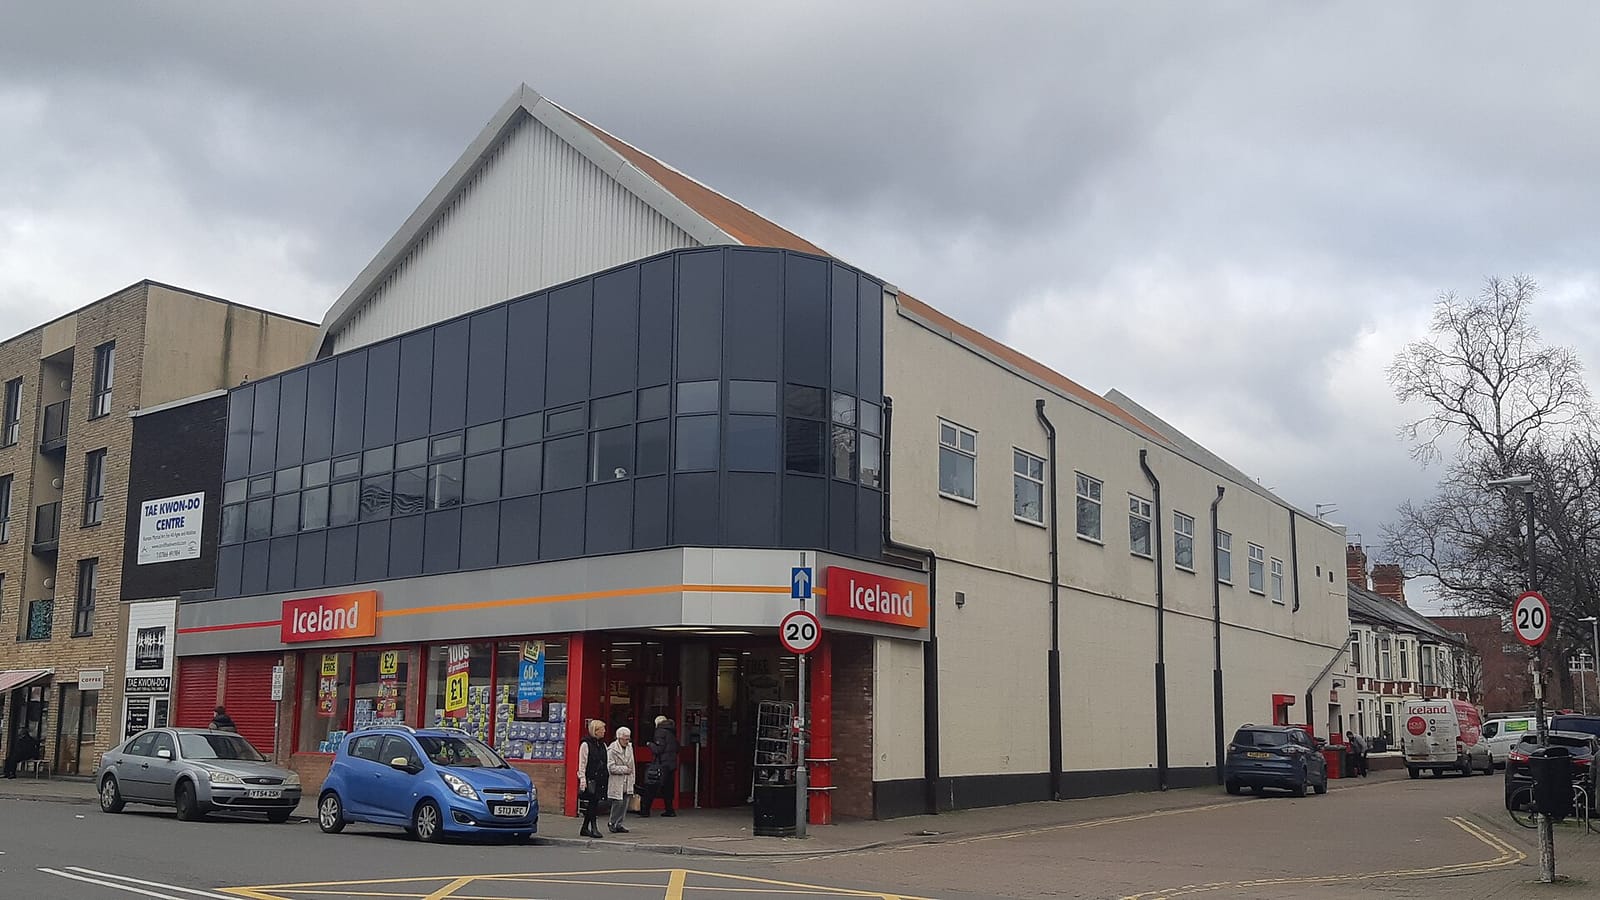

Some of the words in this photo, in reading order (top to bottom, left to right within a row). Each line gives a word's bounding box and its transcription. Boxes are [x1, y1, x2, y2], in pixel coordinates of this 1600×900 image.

[145, 504, 158, 517] TAE
[160, 497, 200, 514] KWON-DO
[156, 516, 185, 531] CENTRE
[850, 579, 913, 618] Iceland
[292, 601, 359, 634] Iceland
[1518, 607, 1544, 629] 20
[786, 623, 815, 641] 20
[384, 653, 395, 669] £2
[452, 662, 469, 673] products
[523, 665, 539, 680] 60+
[127, 678, 137, 687] TAE
[137, 677, 165, 687] KWON-DO
[451, 678, 463, 701] £1
[1408, 705, 1447, 715] Iceland
